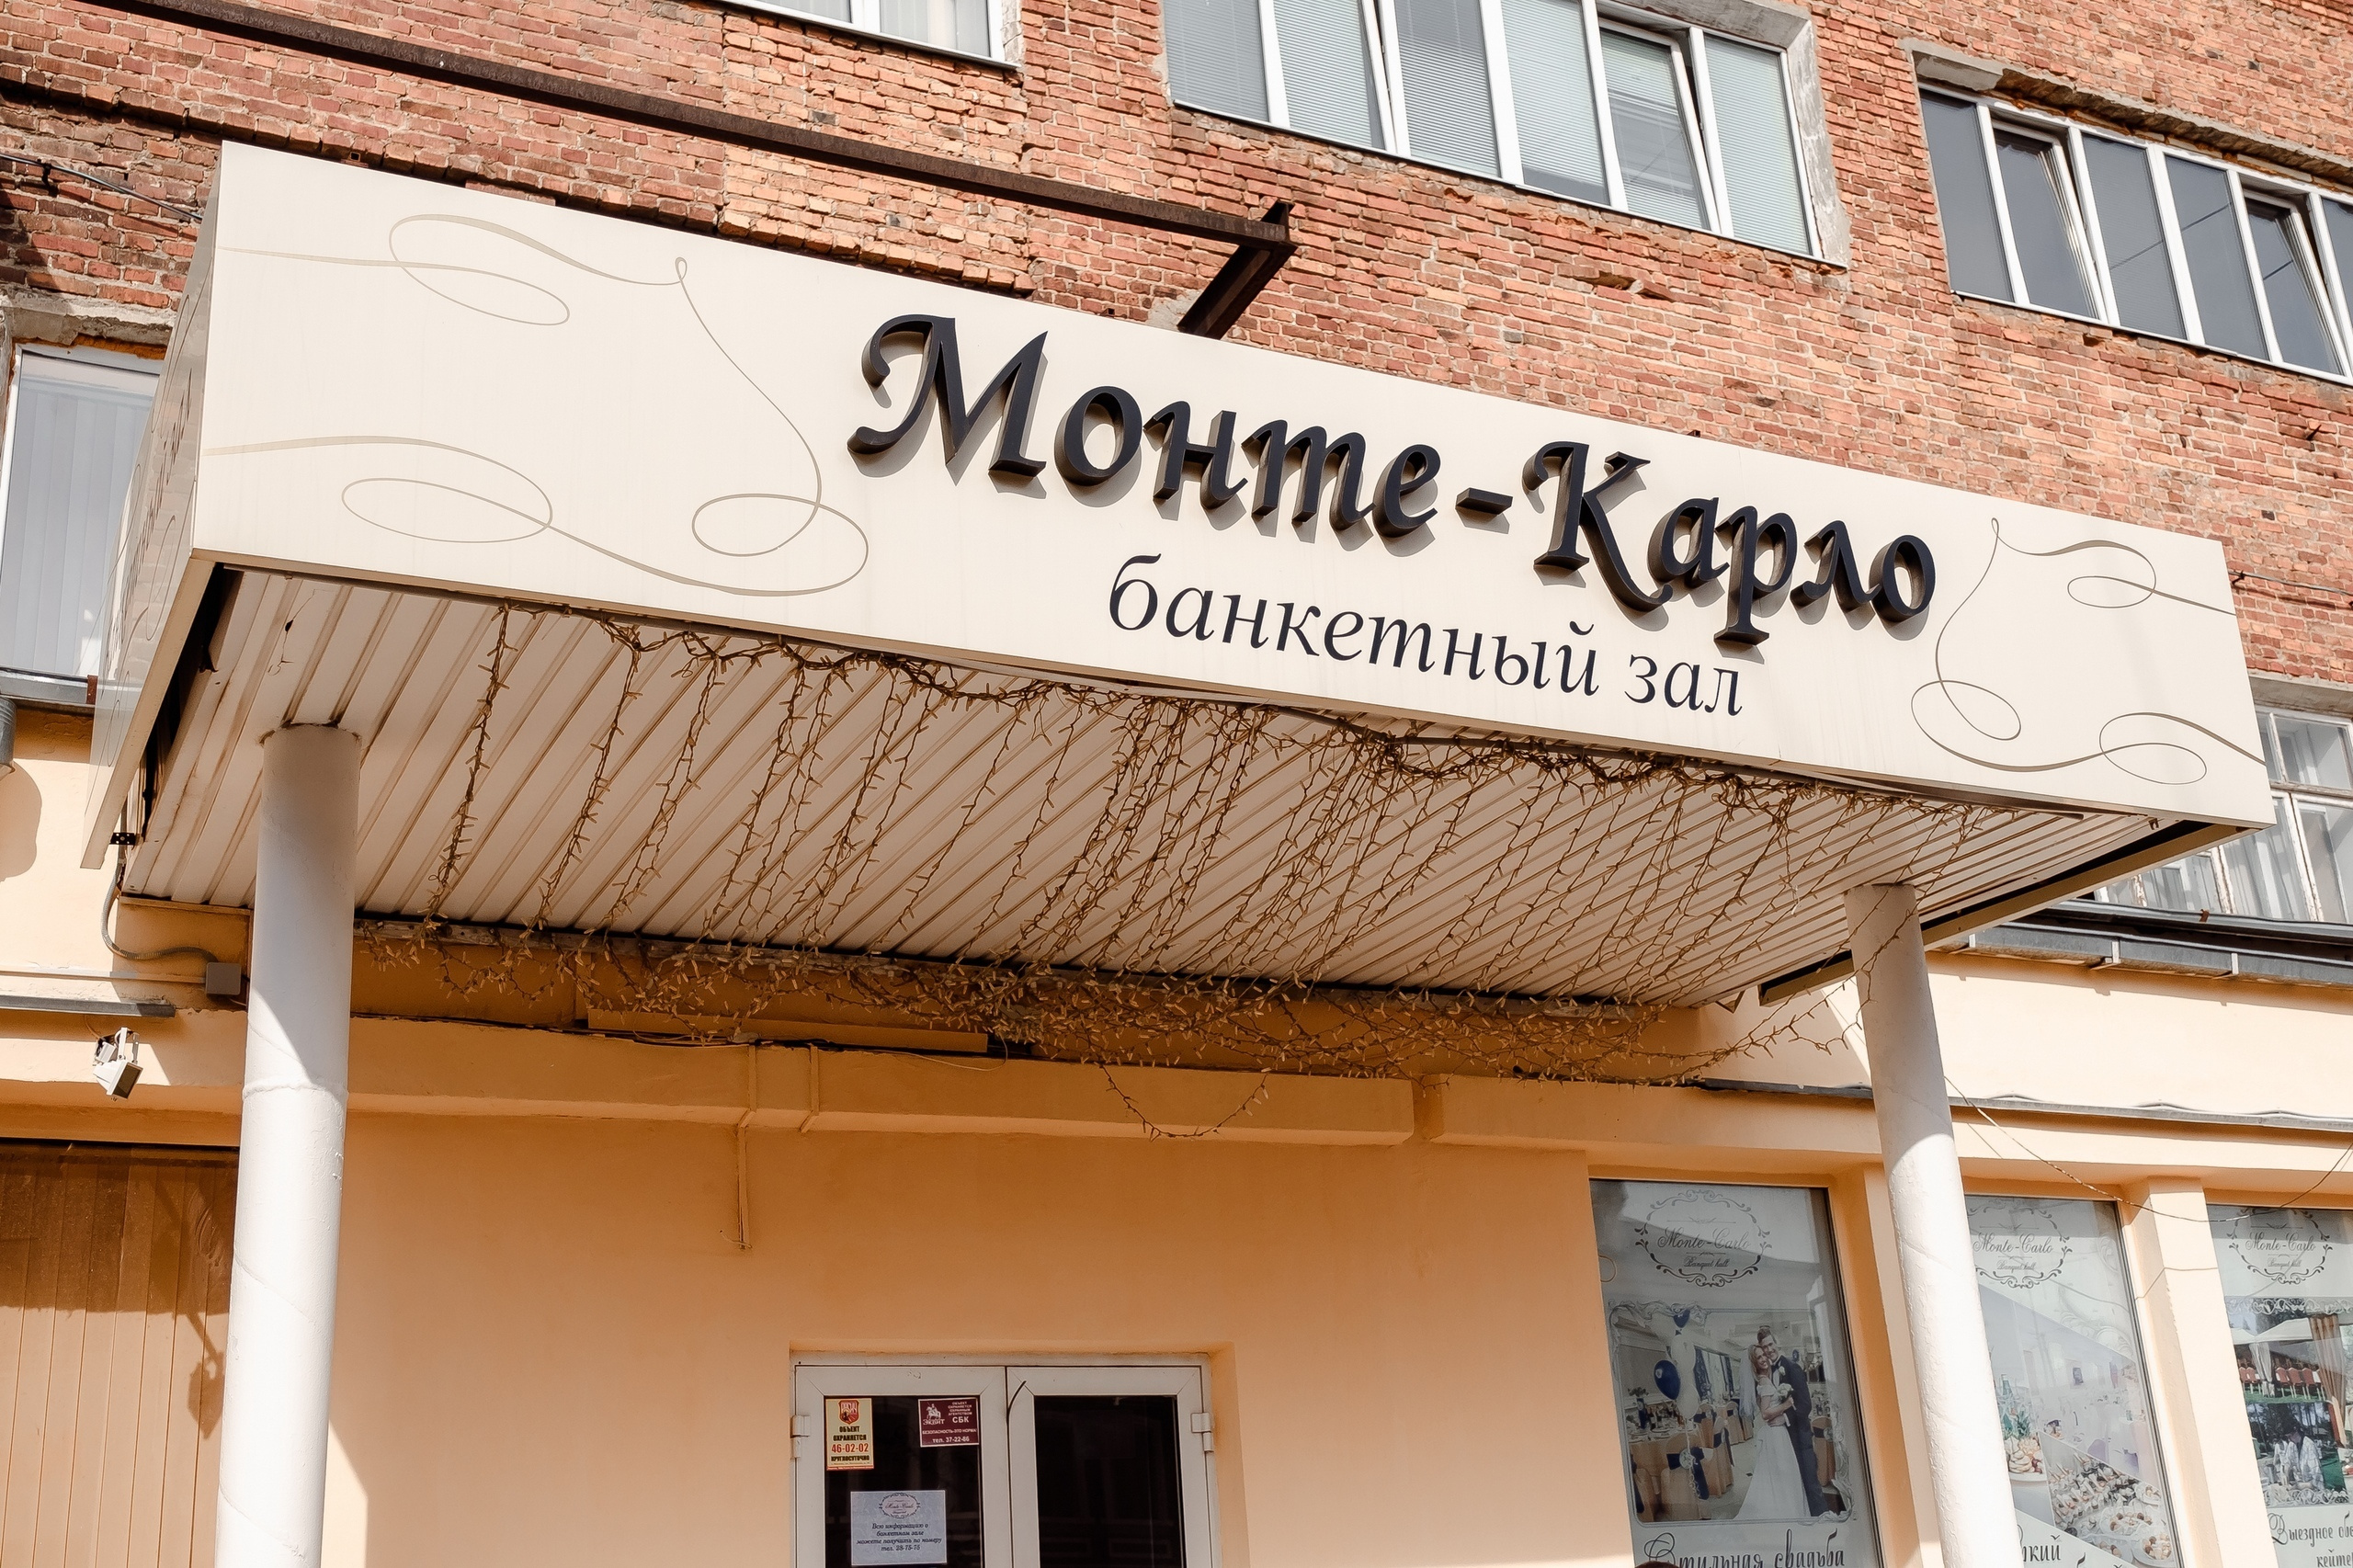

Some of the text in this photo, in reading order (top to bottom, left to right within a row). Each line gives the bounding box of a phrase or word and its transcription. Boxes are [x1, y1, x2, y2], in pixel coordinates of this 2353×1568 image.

[847, 312, 1938, 648] Монте-Карло
[1108, 553, 1744, 717] банкетный зал
[1656, 1226, 1752, 1250] Monte-Carlo
[1972, 1232, 2054, 1253] Monte-Carlo
[2245, 1231, 2317, 1251] Monte-Carlo
[1715, 1257, 1731, 1267] hall
[952, 1415, 970, 1424] СБК
[831, 1442, 870, 1453] 46-02-02
[2268, 1512, 2334, 1548] Выездное
[1774, 1528, 1846, 1568] свадьба
